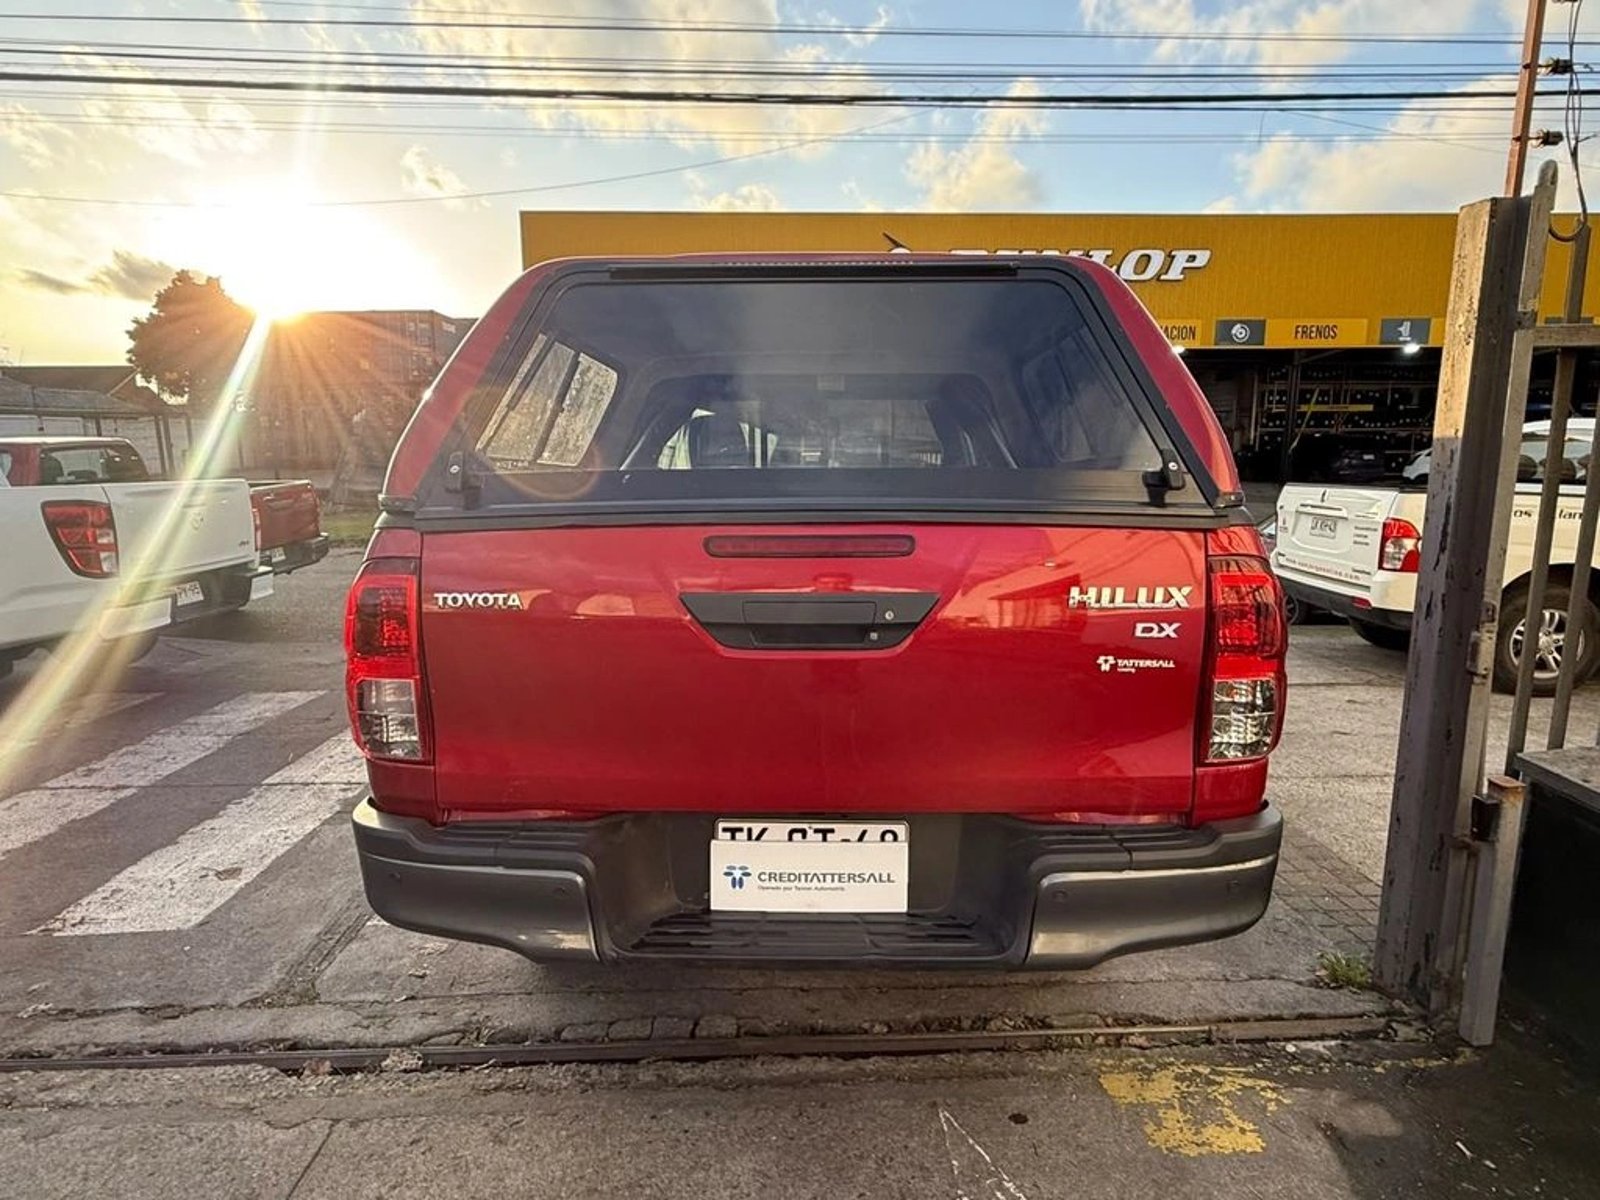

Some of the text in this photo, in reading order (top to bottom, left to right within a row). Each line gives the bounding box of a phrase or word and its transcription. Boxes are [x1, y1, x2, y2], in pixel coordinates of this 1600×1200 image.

[1160, 324, 1196, 341] ACION
[1294, 324, 1338, 340] FRENOS
[433, 592, 523, 610] TOYOTA
[1068, 586, 1192, 608] HILUX
[1134, 622, 1181, 638] DX
[1116, 658, 1176, 668] TATTERSALL
[757, 871, 895, 883] CREDITATTERSALL
